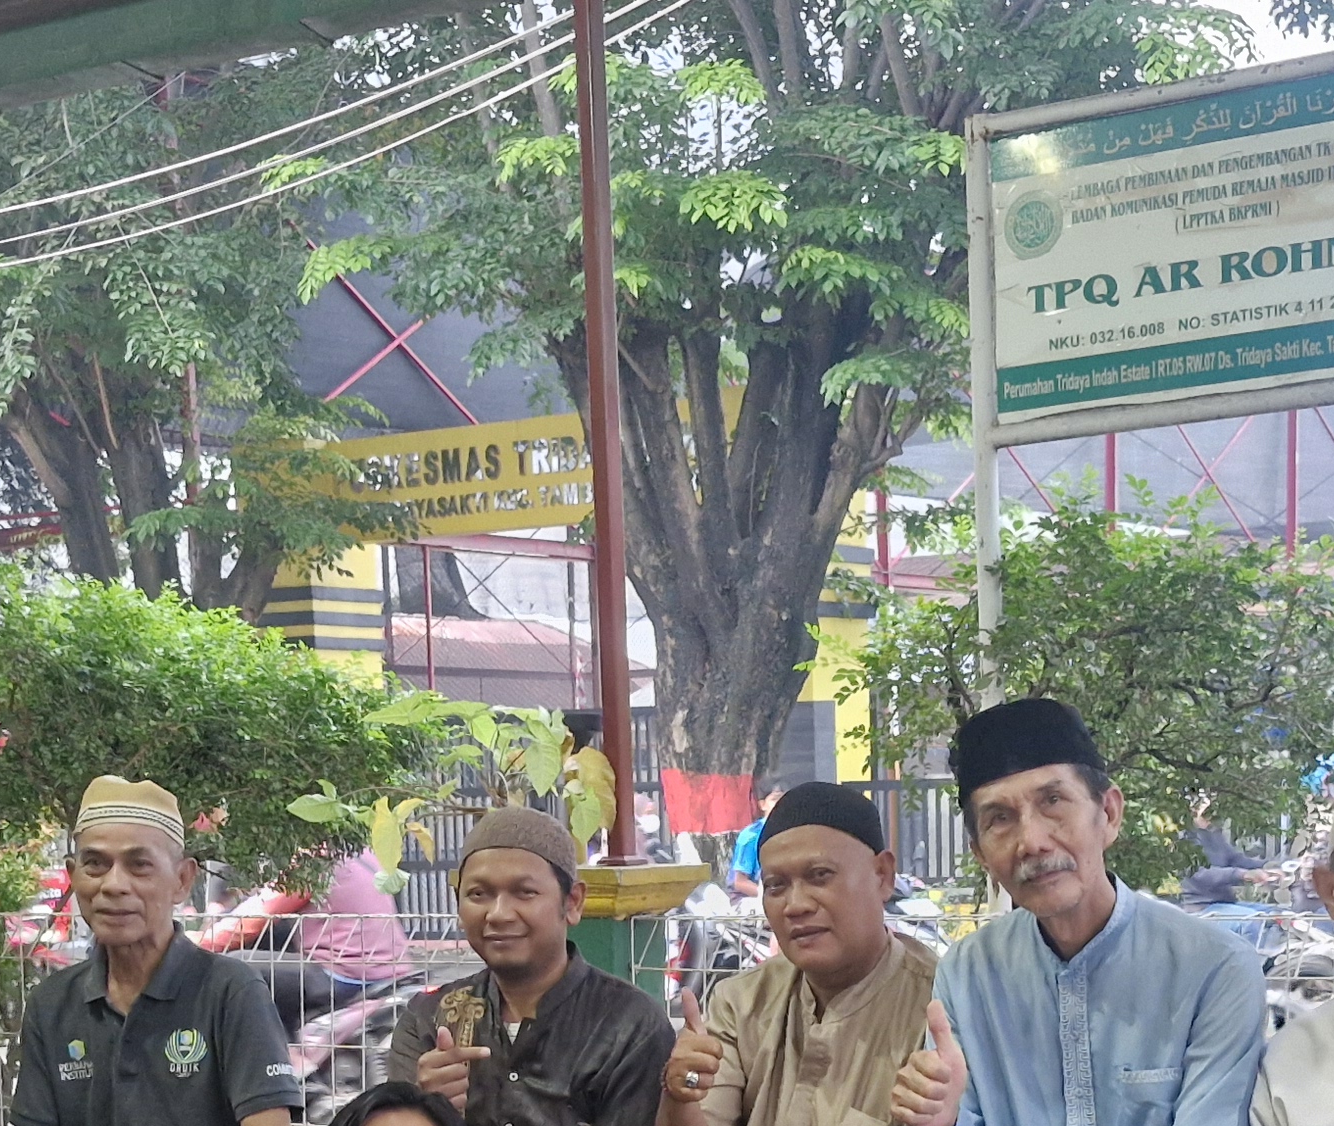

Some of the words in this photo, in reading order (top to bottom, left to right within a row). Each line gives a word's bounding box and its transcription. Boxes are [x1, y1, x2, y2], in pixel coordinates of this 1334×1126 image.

[1070, 178, 1122, 200] LEMBAGA
[1124, 168, 1189, 191] PEMBINAAN
[1191, 163, 1215, 178] DAN
[1217, 144, 1312, 174] PENGEMBANGAN
[1316, 141, 1331, 157] TK
[1071, 208, 1107, 225] BADAN
[1110, 192, 1179, 218] KOMUNIKASI
[1181, 183, 1228, 206] PEMUDA
[1231, 175, 1277, 197] REMAJA
[1279, 167, 1324, 189] MASJID
[1025, 273, 1120, 314] TPQ
[1132, 258, 1204, 299] AR
[1048, 336, 1086, 351] NKU:
[1089, 321, 1166, 345] 032.16.008
[1178, 316, 1206, 332] NO:
[1210, 302, 1289, 327] STATISTIK
[1003, 379, 1055, 400] Perumahan
[1056, 371, 1091, 394] Tridaya
[1092, 369, 1118, 385] Indah
[1120, 363, 1151, 382] Estate
[1157, 357, 1185, 377] RT.05
[1186, 352, 1215, 373] RW.07
[1218, 350, 1235, 370] Ds.
[1236, 347, 1273, 368] Tridaya
[1274, 341, 1300, 361] Sakti
[1302, 338, 1325, 356] Kec.
[350, 444, 501, 494] USKESMAS
